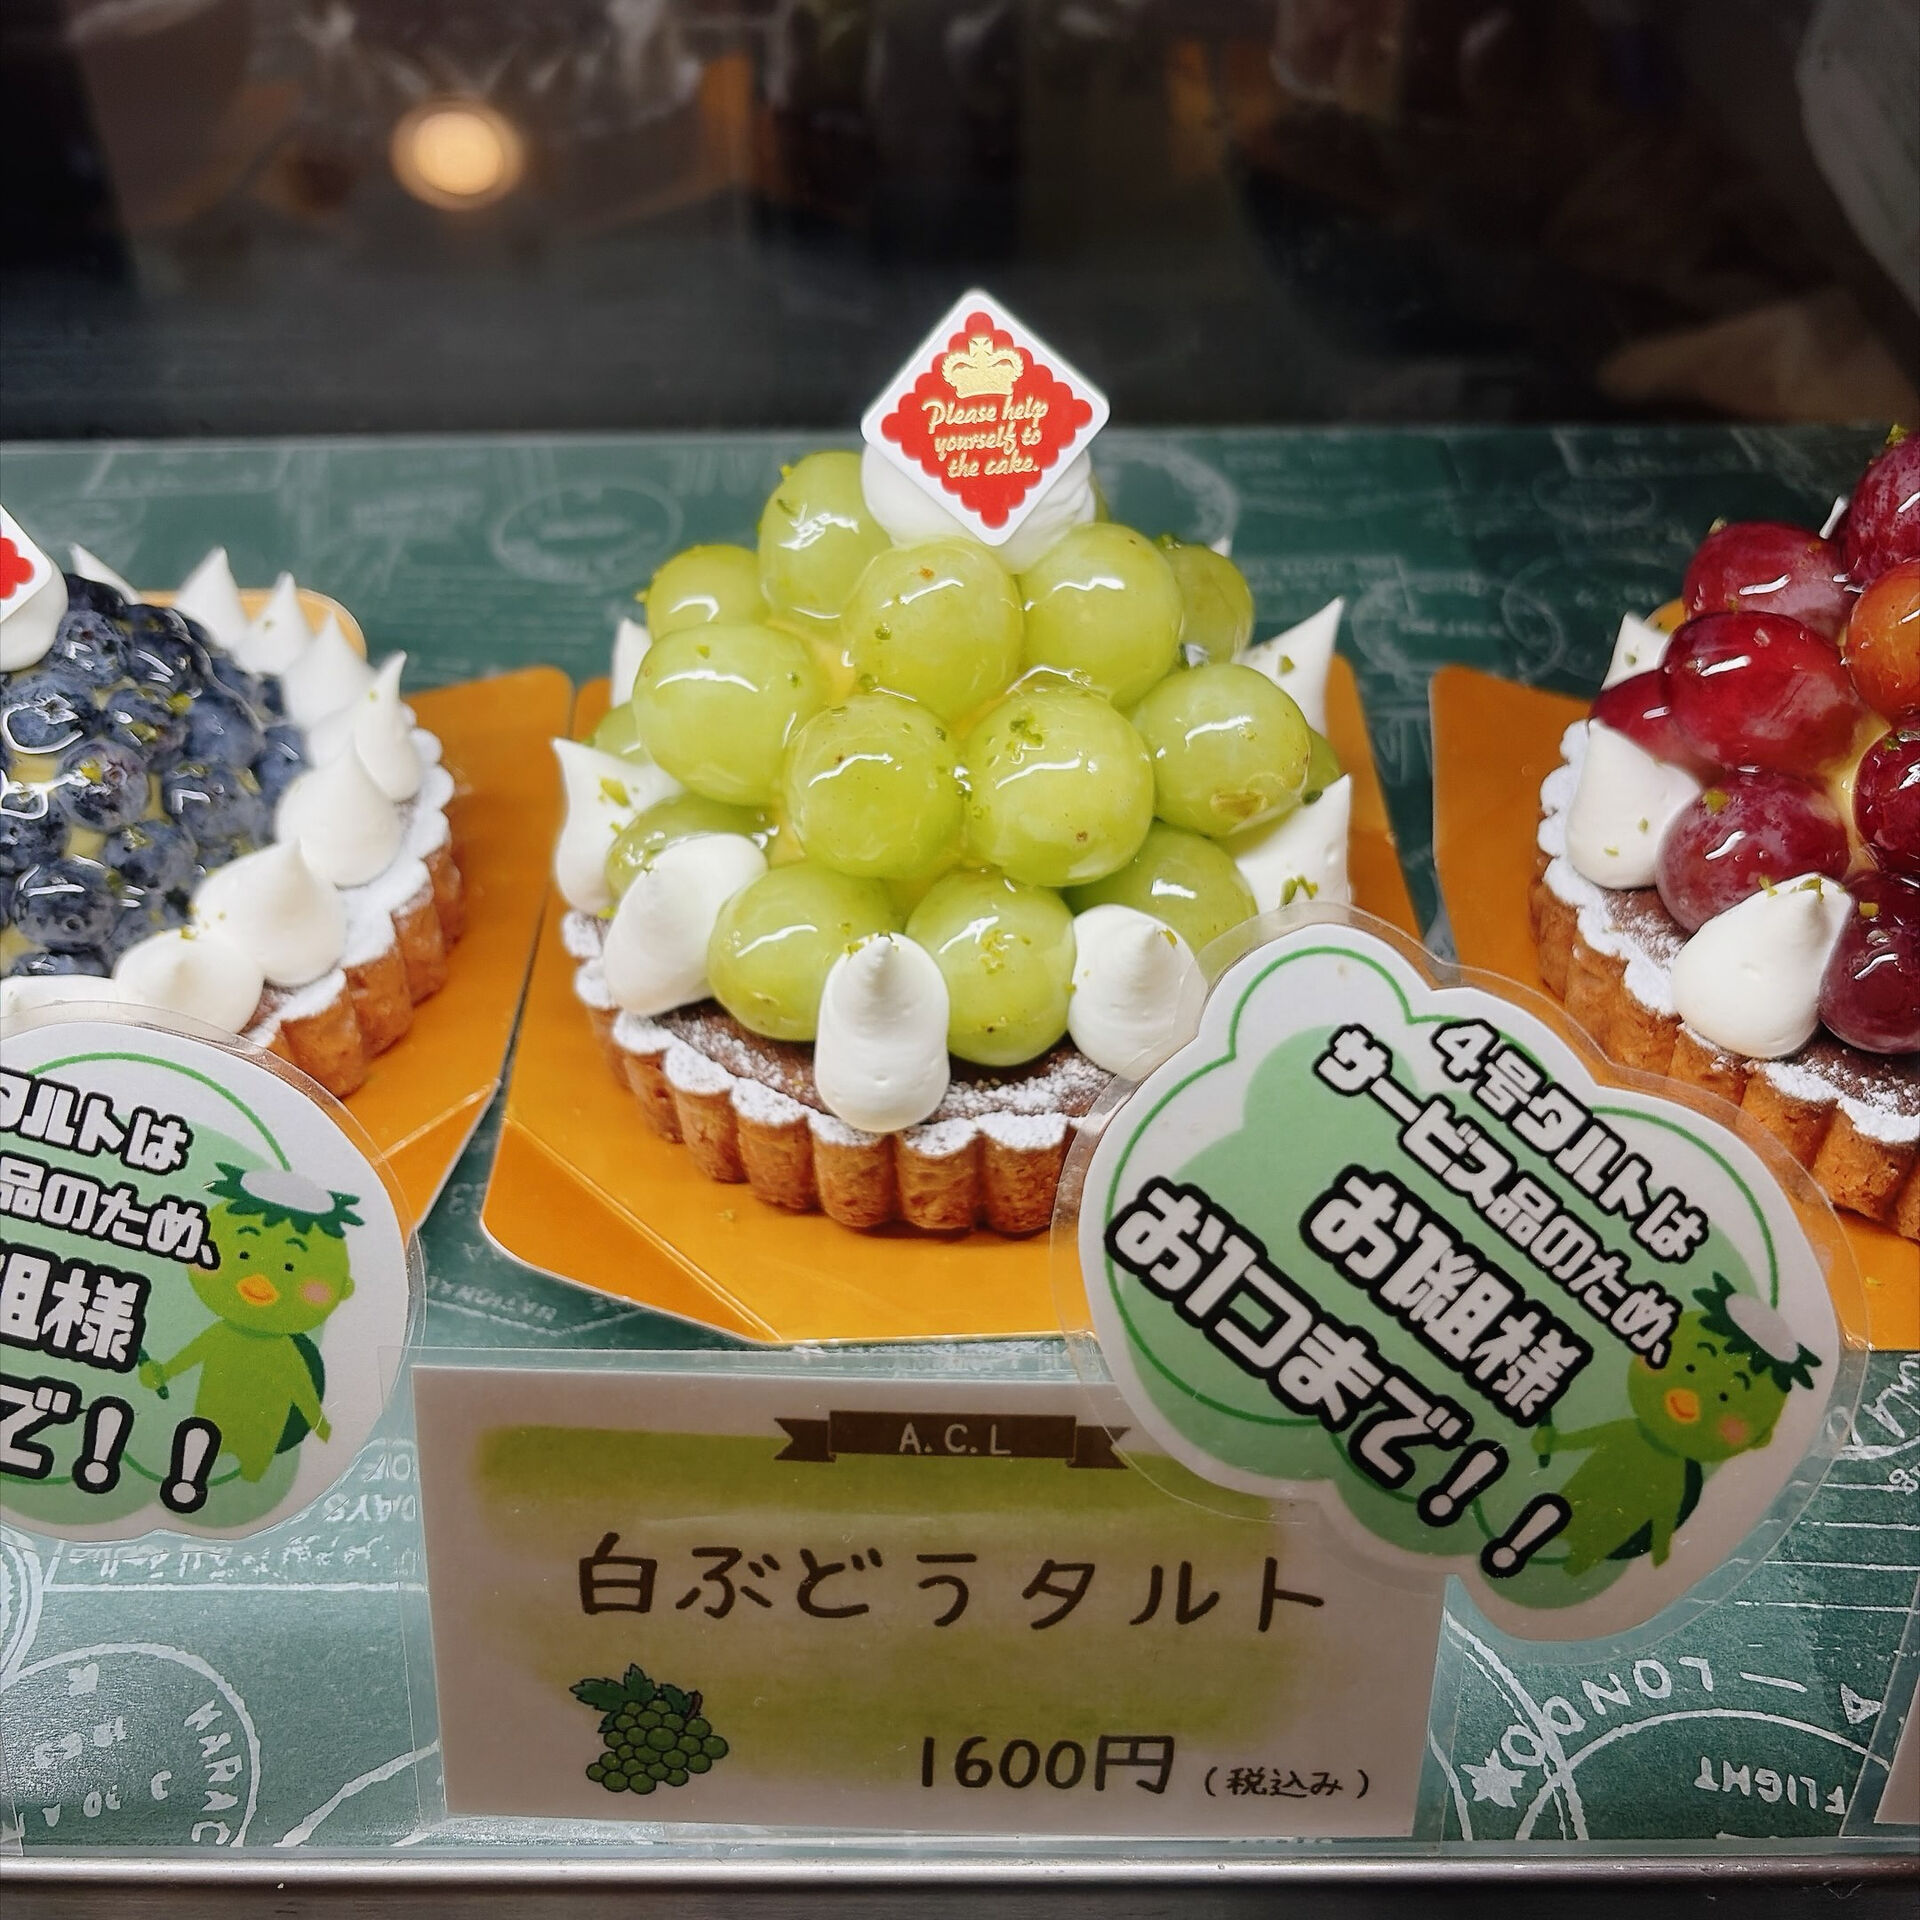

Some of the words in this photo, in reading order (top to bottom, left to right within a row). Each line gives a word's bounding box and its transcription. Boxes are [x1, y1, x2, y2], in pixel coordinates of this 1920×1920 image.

[921, 398, 998, 435] Please
[1001, 396, 1049, 428] help
[934, 423, 1018, 461] yourself
[1021, 427, 1042, 447] to
[947, 452, 979, 478] the
[984, 454, 1041, 477] cake.
[1431, 1019, 1709, 1263] 4号タルトは
[1312, 1024, 1682, 1369] サービス品のため、
[1300, 1164, 1593, 1427] お1組様
[577, 1531, 1325, 1633] 白ぶどうタルト
[921, 1734, 1176, 1795] 1600円
[1693, 1756, 1847, 1815] FLIGHT
